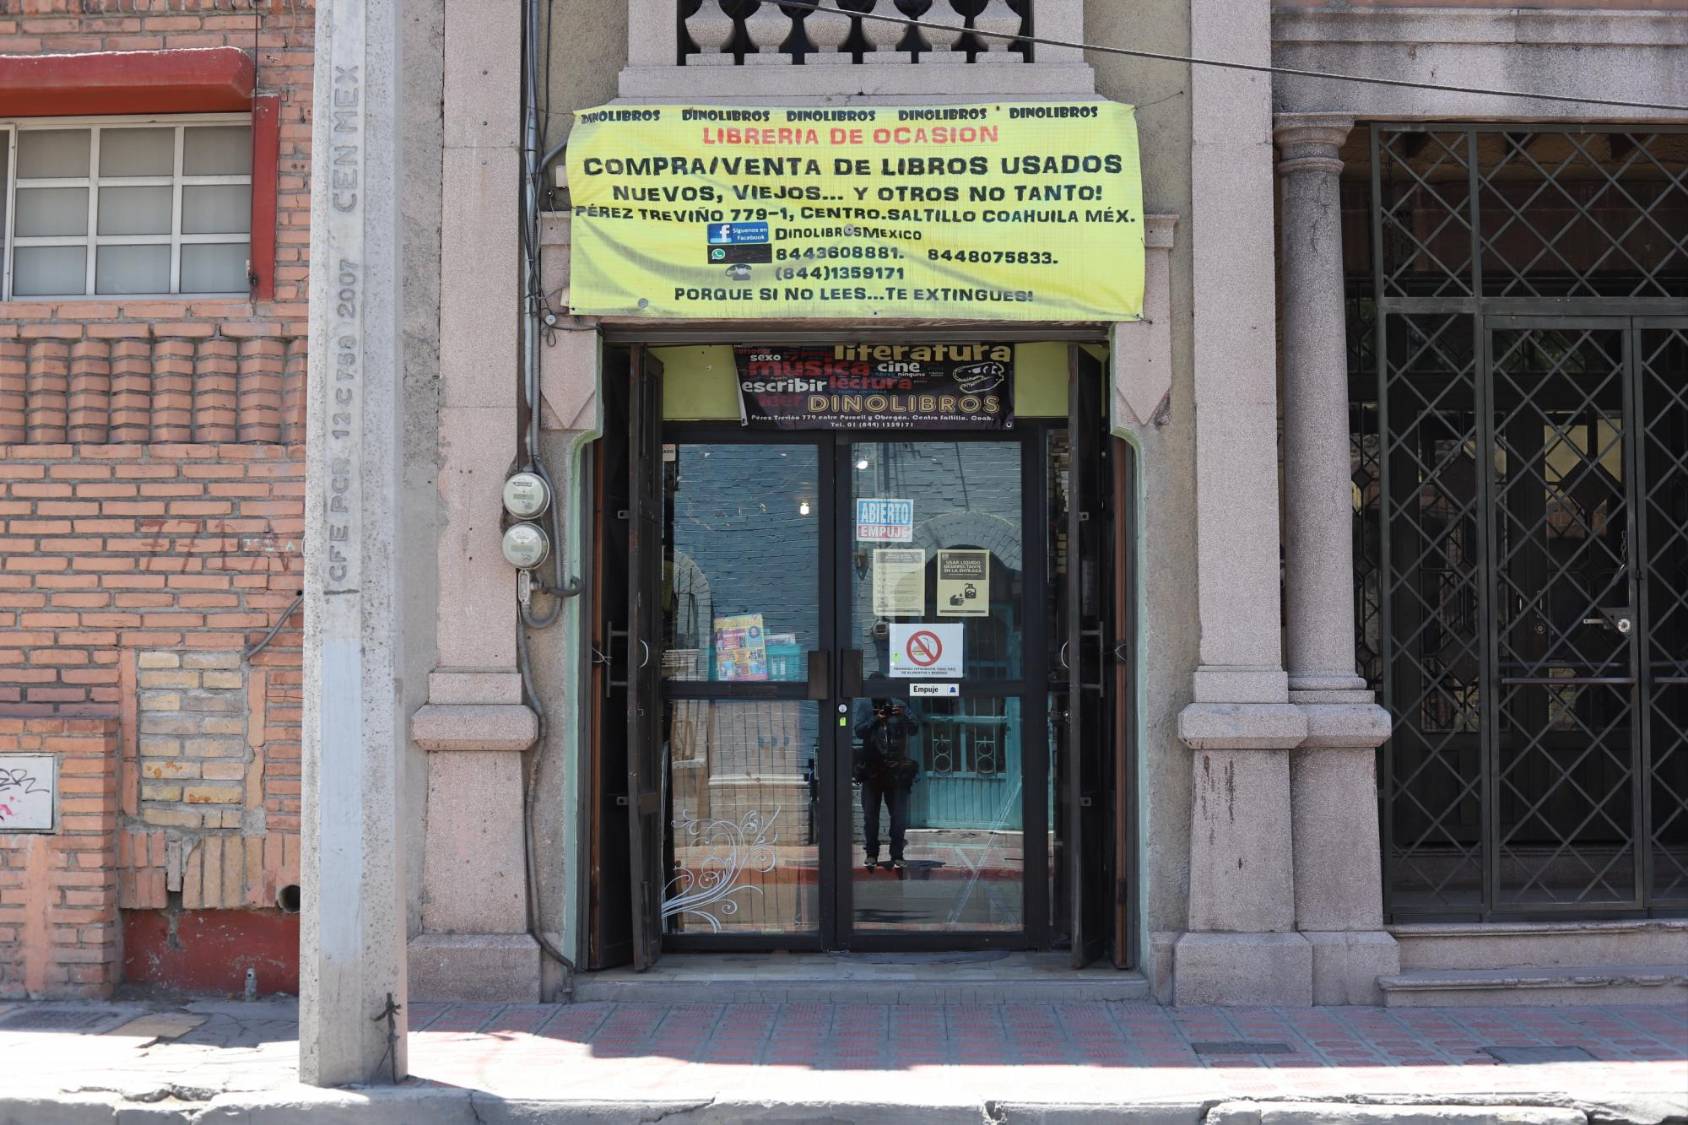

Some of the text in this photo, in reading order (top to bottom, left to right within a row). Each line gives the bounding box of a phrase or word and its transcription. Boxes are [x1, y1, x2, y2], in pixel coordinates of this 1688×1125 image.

[334, 65, 360, 133] MEX
[581, 106, 1098, 124] DINOLIBROS DINOLIBROS DINOLIBROS DINOLIBROS DINOLIBROS
[703, 125, 999, 145] LIBRERIA DE OCASION
[583, 154, 1123, 177] COMPRA/VENTA DE LIBROS USADOS
[332, 145, 359, 213] CEN
[612, 184, 1103, 204] NUEVOS, VIEJOS... Y OTROS NO TANTO!
[575, 203, 634, 220] PÉREZ
[640, 207, 724, 223] TREVIÑO
[730, 207, 794, 223] 779-1,
[982, 209, 1078, 223] COAHUILA
[1085, 206, 1136, 223] MÉX.
[775, 246, 1059, 264] 8443608881. 8448075833.
[775, 266, 904, 281] (844)1359171
[336, 258, 359, 320] 2007
[674, 288, 753, 301] PORQUE
[760, 288, 778, 301] SI
[785, 288, 814, 301] NO
[913, 288, 1034, 302] EXTINGUES!
[750, 354, 781, 362] sexo
[834, 344, 1011, 362] literatura
[877, 361, 920, 373] cine
[742, 378, 828, 393] escribir
[829, 375, 912, 390] lectura
[808, 394, 1000, 414] DINOLIBROS
[331, 455, 350, 514] PCR
[861, 503, 909, 524] ABIERTO
[860, 525, 911, 538] EMPUJE
[329, 524, 349, 582] CFE
[913, 685, 939, 694] Empuje
